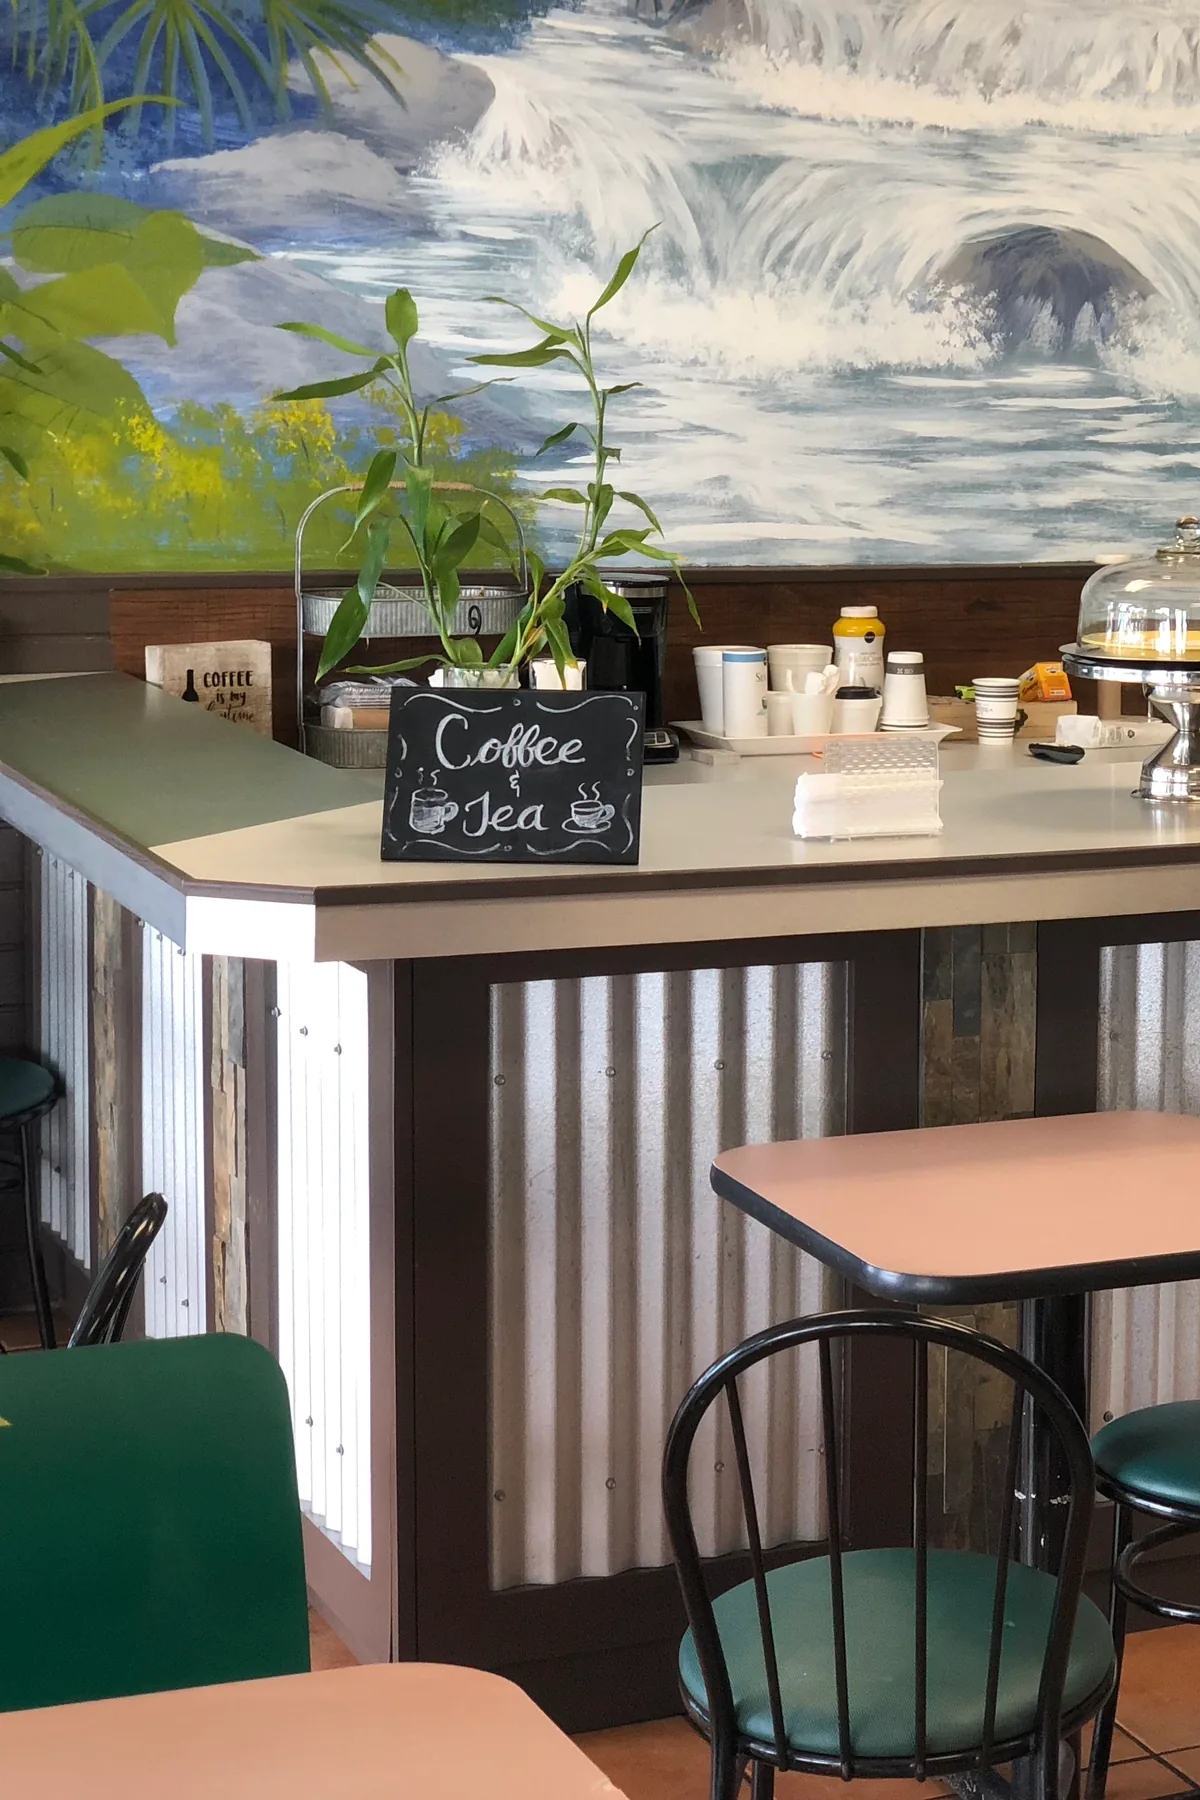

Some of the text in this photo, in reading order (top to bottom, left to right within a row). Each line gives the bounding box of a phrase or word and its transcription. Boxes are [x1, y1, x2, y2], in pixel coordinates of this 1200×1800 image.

[203, 670, 254, 688] COFFEE
[215, 688, 247, 706] is my
[435, 713, 586, 769] Coffee
[462, 791, 550, 837] Tea
